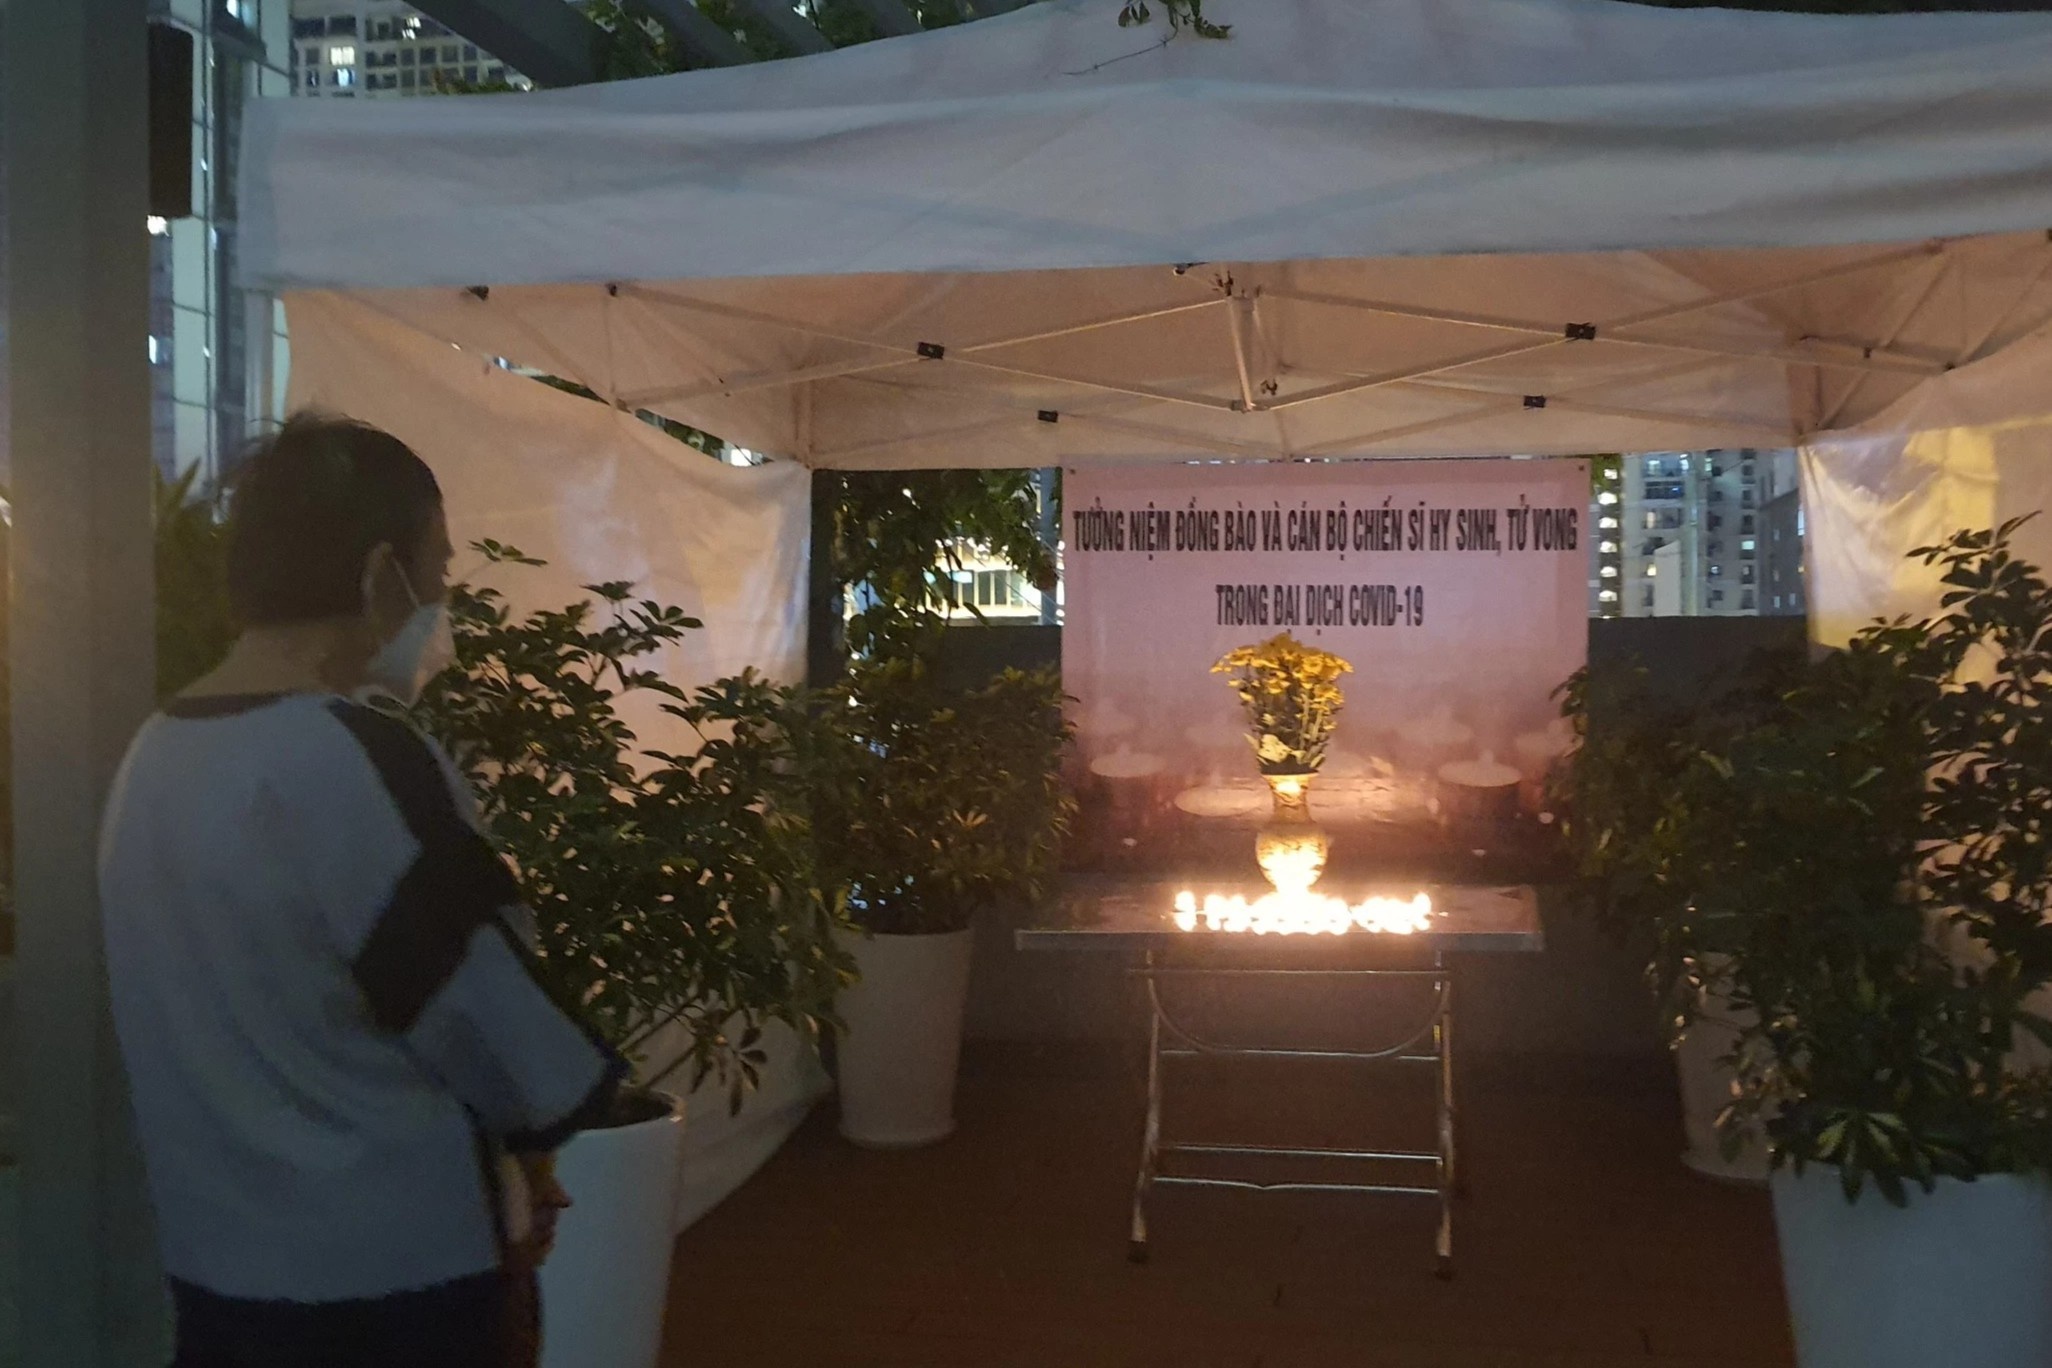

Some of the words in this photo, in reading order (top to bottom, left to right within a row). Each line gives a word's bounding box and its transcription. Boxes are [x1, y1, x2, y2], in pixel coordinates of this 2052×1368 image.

[1129, 501, 1171, 561] NIỆM
[1224, 501, 1257, 551] BÀO
[1260, 500, 1283, 551] VÀ
[1287, 500, 1321, 551] CÁN
[1326, 500, 1348, 561] BỘ
[1353, 495, 1403, 551] CHIẾN
[1429, 508, 1451, 551] HY
[1456, 508, 1502, 556] SINH,
[1507, 493, 1530, 551] TỬ
[1532, 508, 1578, 551] VONG
[1216, 584, 1269, 626] TRONG
[1274, 584, 1301, 636] ĐẠI
[1306, 584, 1344, 636] DỊCH
[1350, 584, 1424, 627] COVID-19
